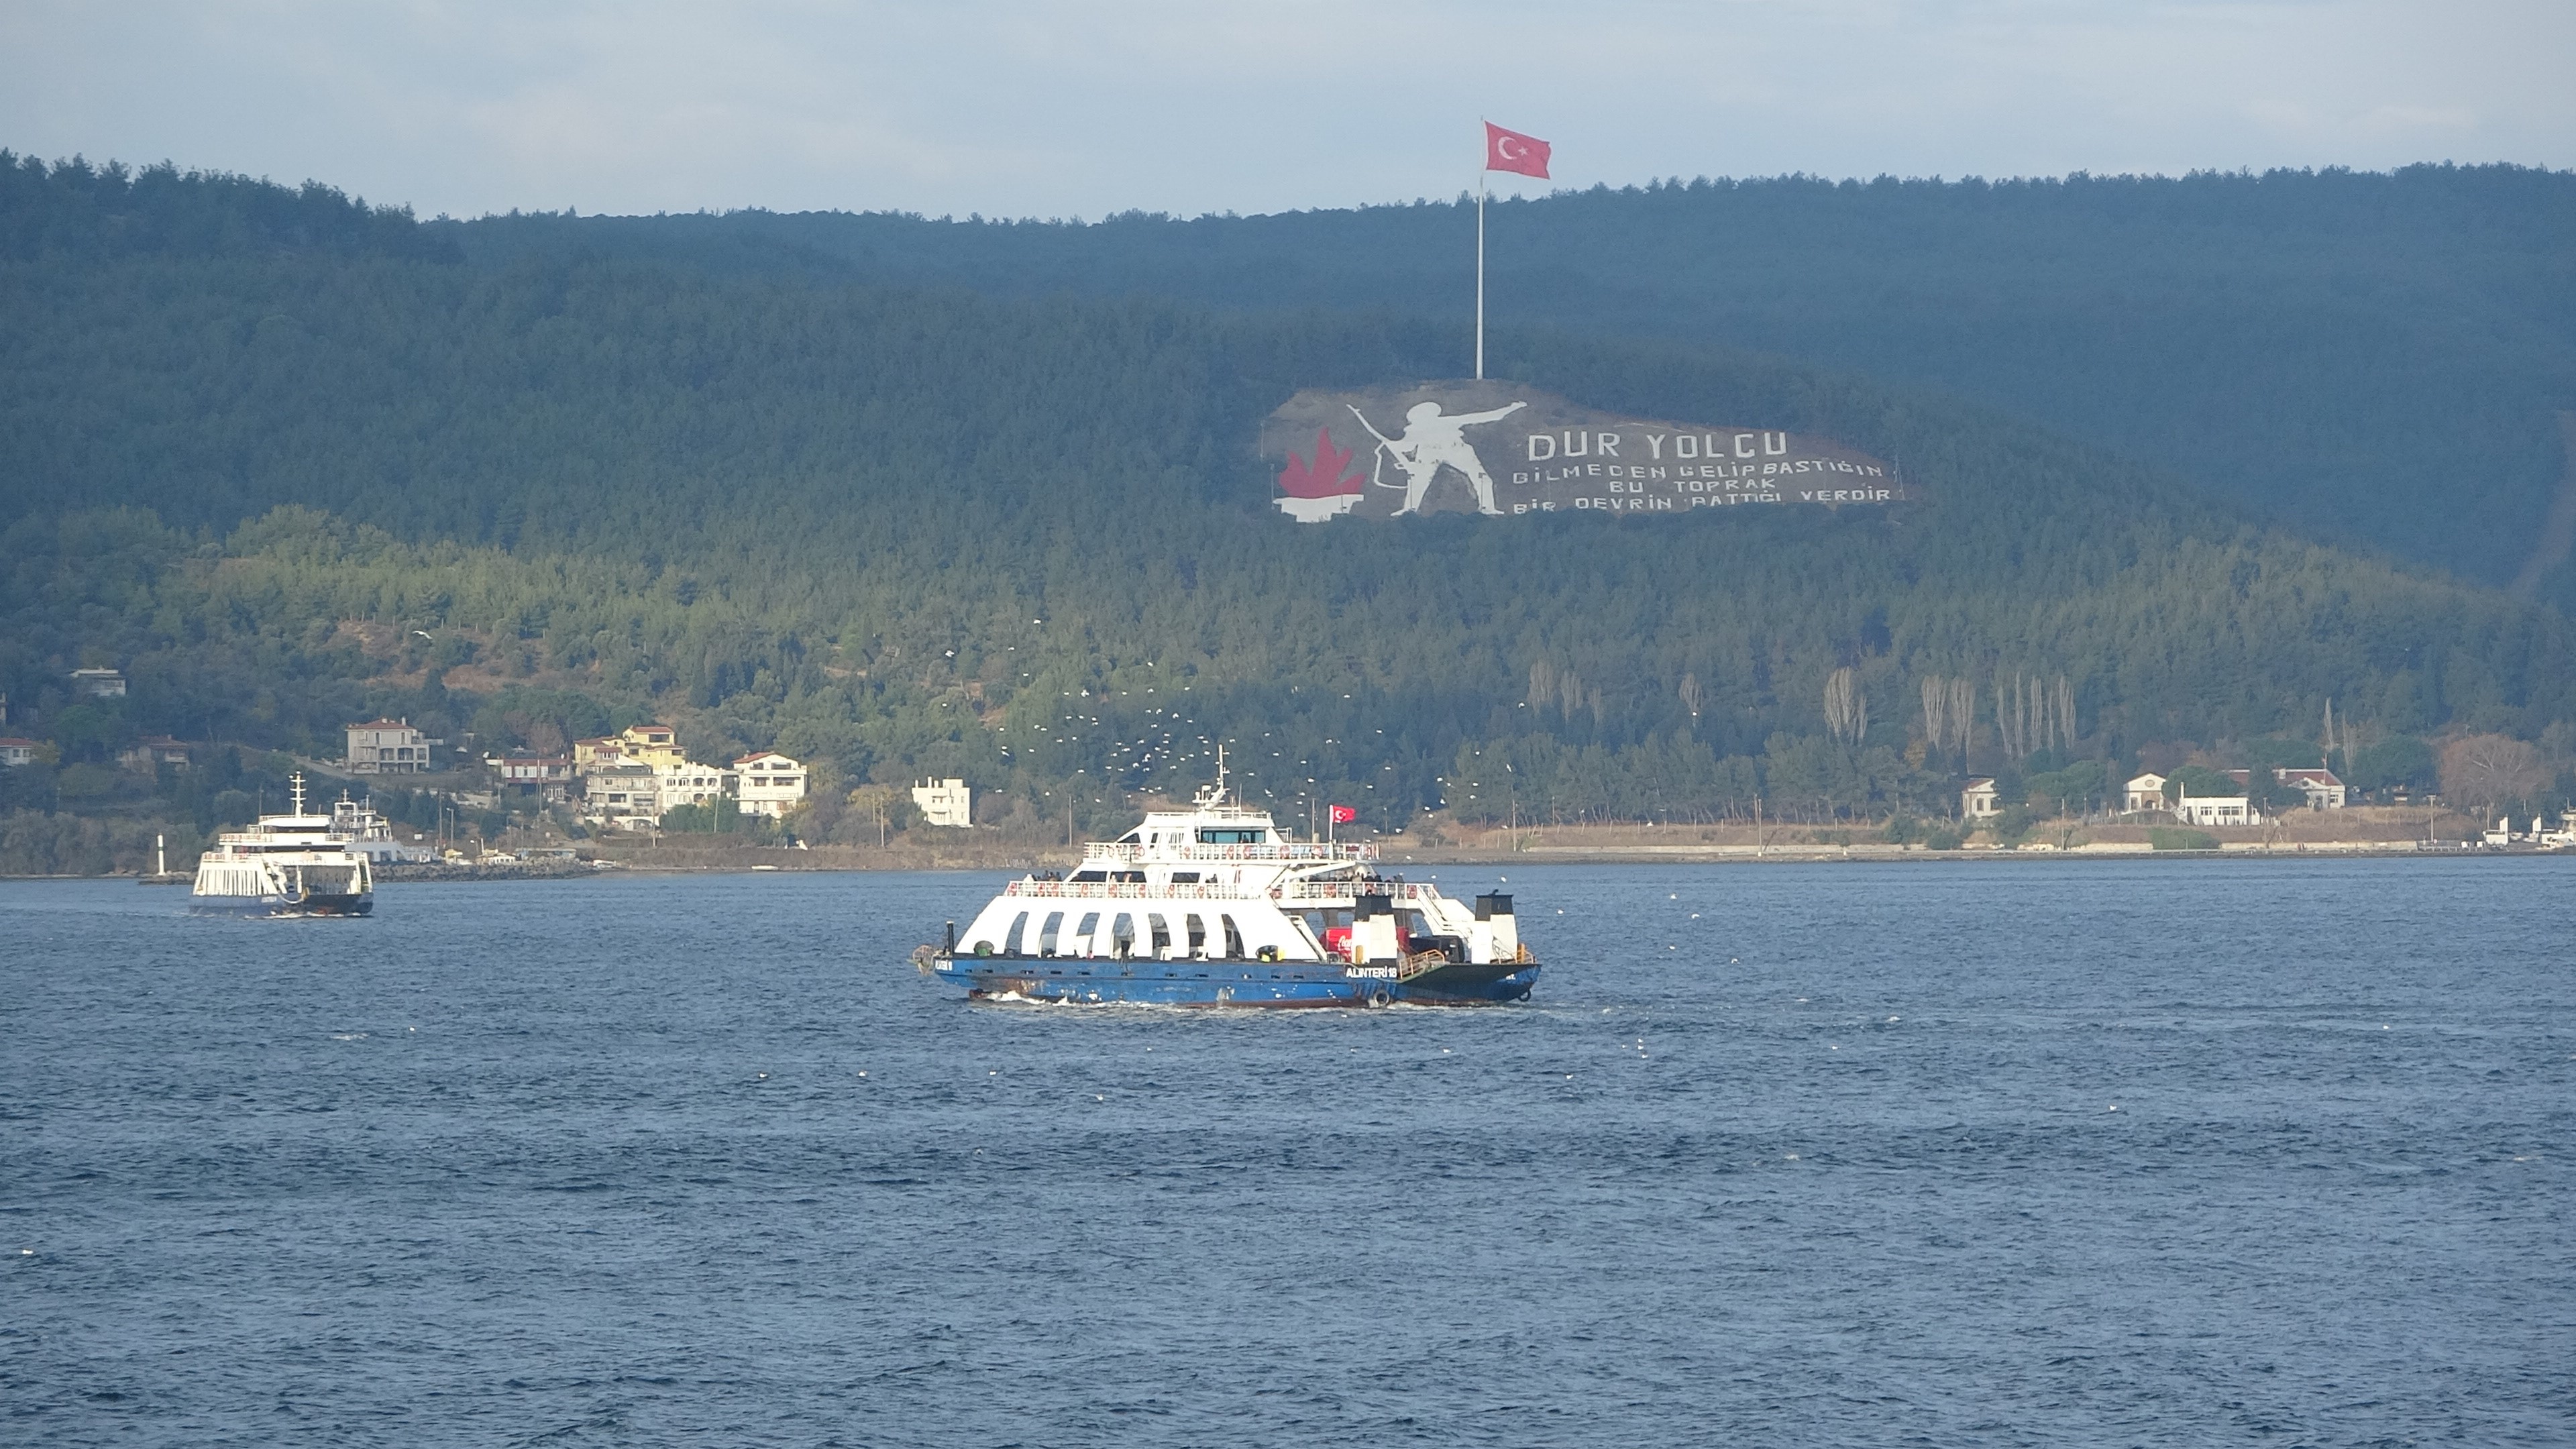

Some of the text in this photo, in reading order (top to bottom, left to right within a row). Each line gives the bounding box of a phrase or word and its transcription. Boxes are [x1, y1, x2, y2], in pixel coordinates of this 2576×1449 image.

[1528, 431, 1787, 461] DUR YOLCU
[1513, 460, 1883, 484] BİLMEDEN GELİP BASTIĞIN
[1609, 478, 1776, 493] BU TOPRAK
[1513, 498, 1556, 515] BİR
[1575, 494, 1672, 510] DEVRİN
[1801, 486, 1890, 501] YERDİR
